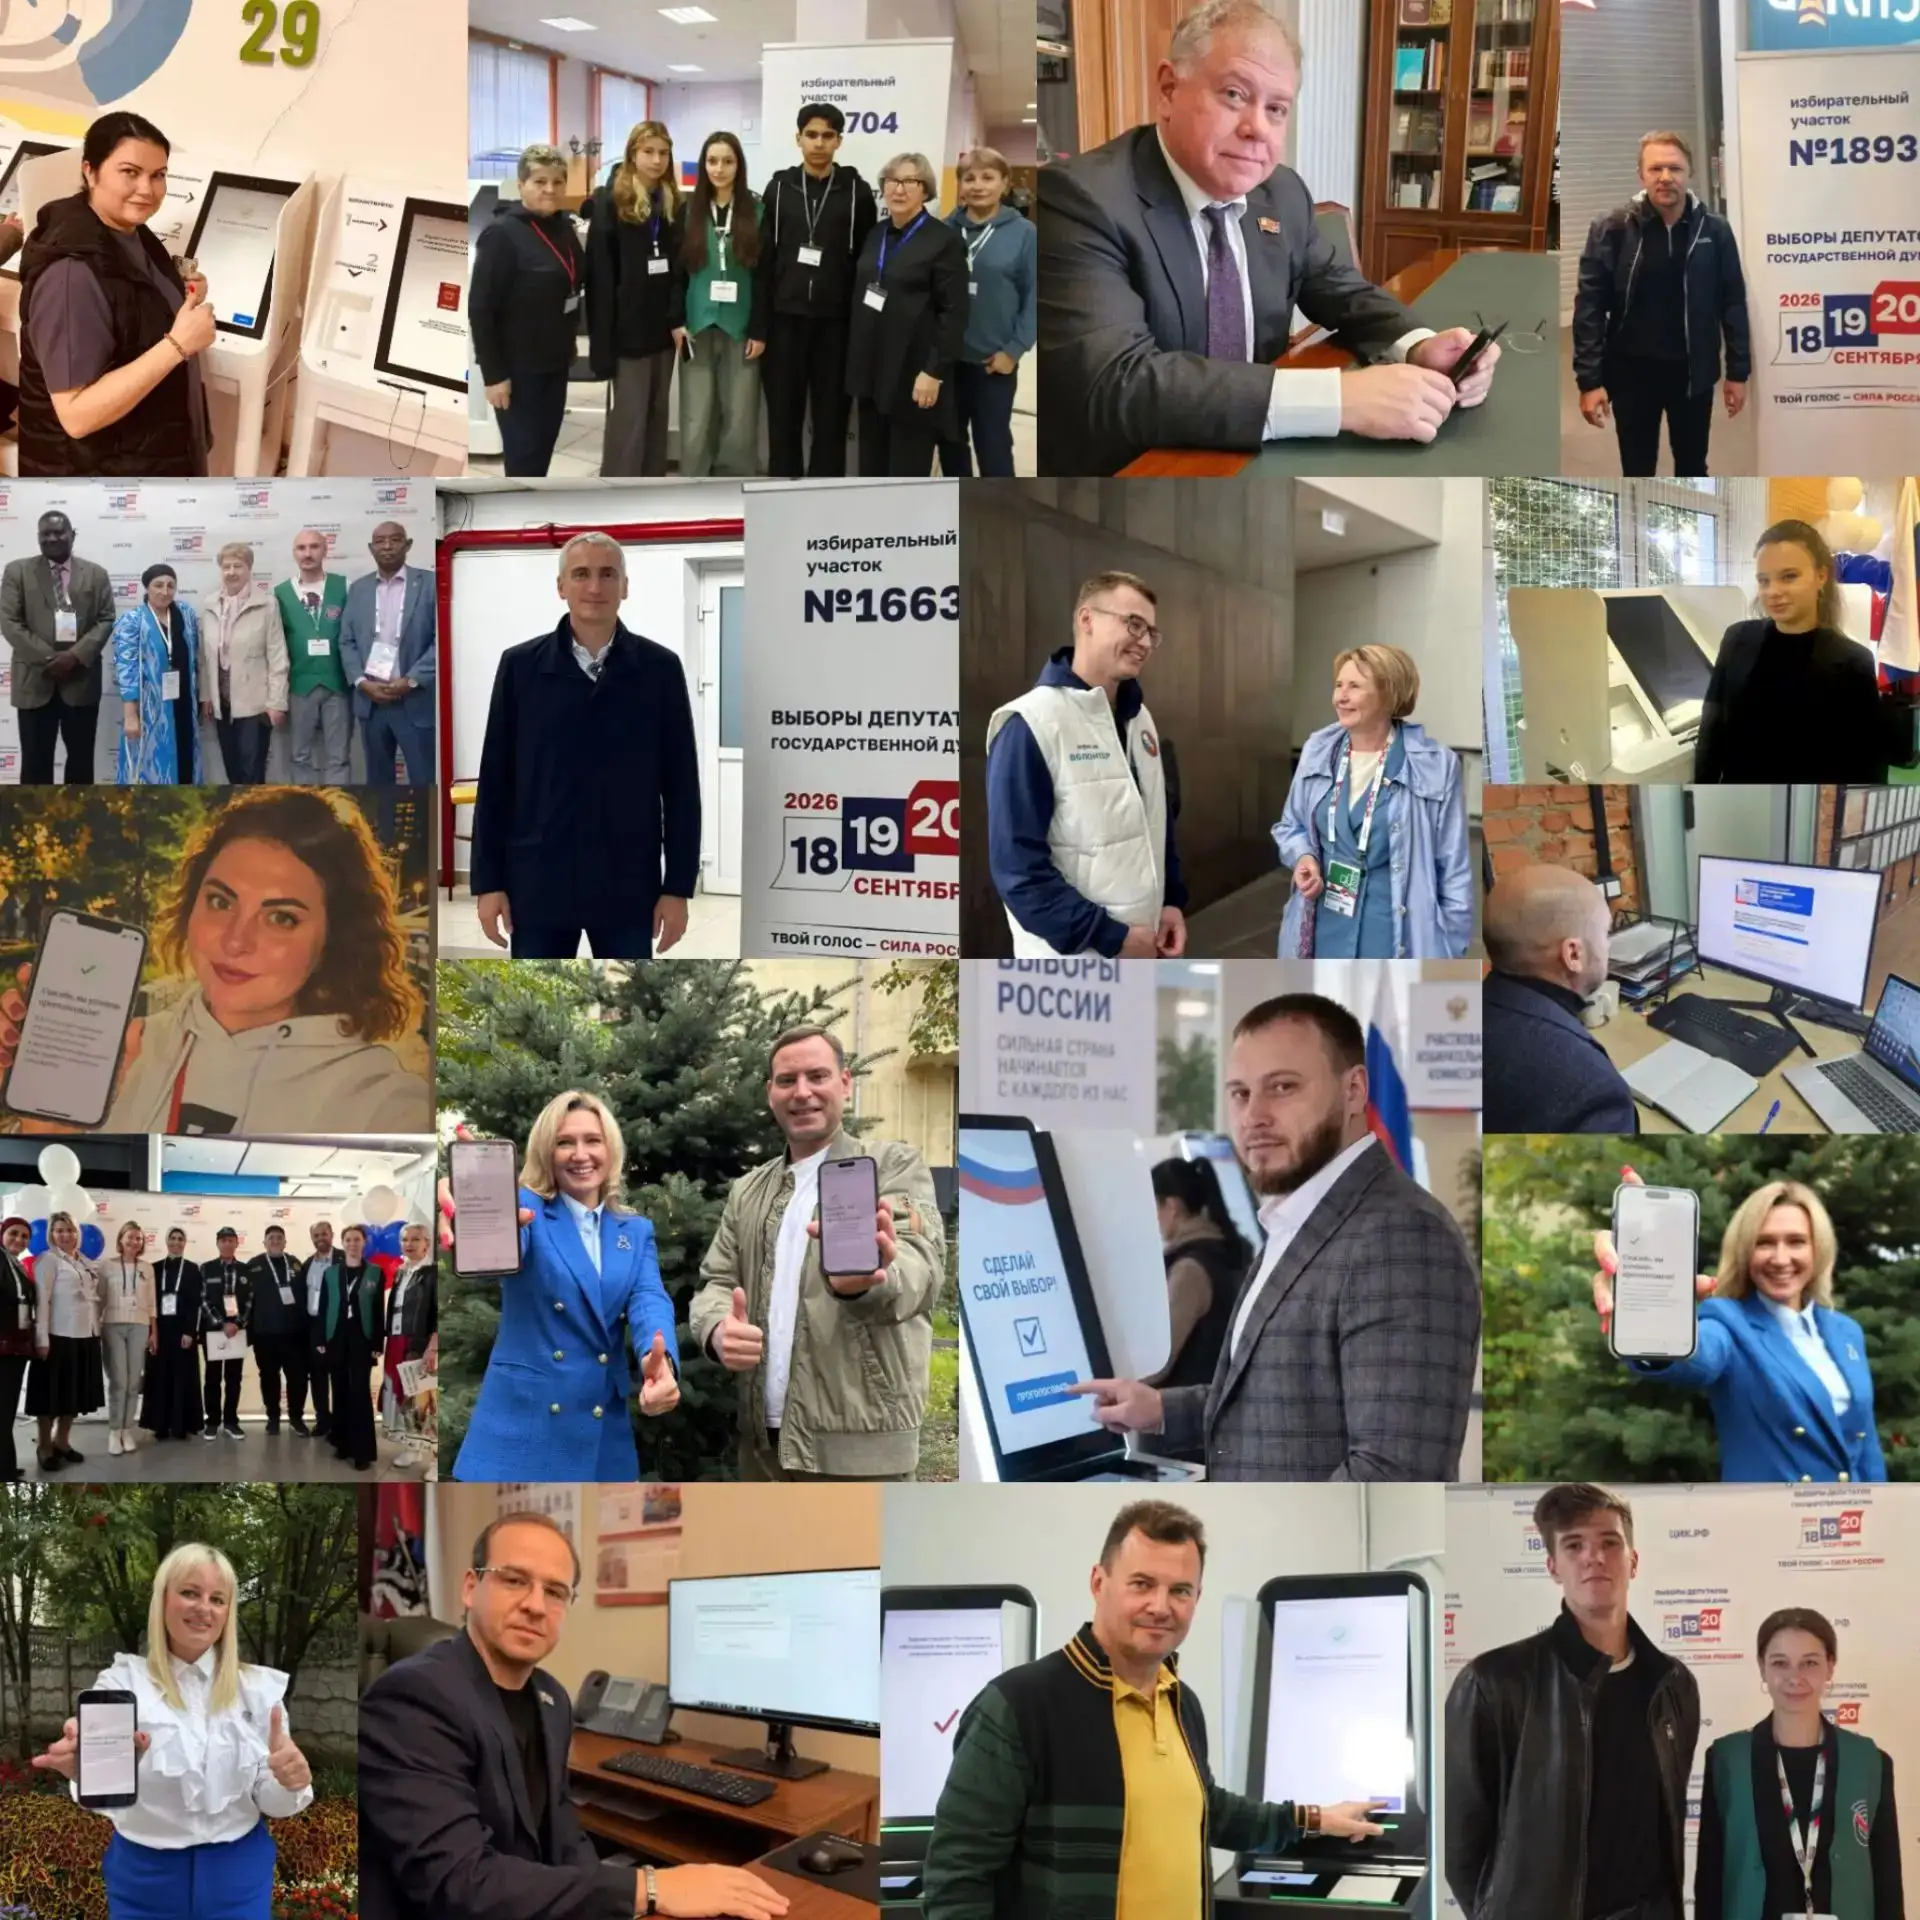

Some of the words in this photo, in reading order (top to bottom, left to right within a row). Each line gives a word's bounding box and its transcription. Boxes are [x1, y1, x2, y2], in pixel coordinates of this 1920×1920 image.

[240, 0, 320, 67] 29
[801, 76, 896, 89] избирательный
[801, 93, 848, 104] участок
[1790, 91, 1910, 110] избирательный
[843, 111, 899, 134] 704
[1791, 115, 1851, 129] участок
[1790, 134, 1918, 166] №1893
[1767, 232, 1837, 245] ВЫБОРЫ
[1767, 249, 1896, 264] ГОСУДАРСТВЕННОЙ
[1779, 293, 1821, 307] 2026
[1785, 325, 1822, 353] 18
[1829, 308, 1867, 336] 19
[1875, 294, 1920, 323] 20
[1773, 393, 1802, 404] ТВОЙ
[1805, 393, 1840, 403] ГОЛОС
[1853, 393, 1883, 402] СИЛА
[807, 530, 957, 553] избирательный
[806, 560, 883, 577] участок
[804, 585, 959, 624] №1663
[771, 710, 862, 727] ВЫБОРЫ
[771, 736, 939, 753] ГОСУДАРСТВЕННОЙ
[784, 792, 839, 811] 2026
[790, 836, 839, 875] 18
[850, 816, 900, 856] 19
[911, 798, 959, 839] 20
[854, 877, 959, 900] СЕНТЯБР
[771, 931, 810, 946] ТВОЙ
[813, 935, 863, 949] ГОЛОС
[880, 939, 921, 955] СИЛА
[926, 943, 959, 958] РОС
[998, 981, 1111, 1023] РОССИИ
[997, 1034, 1063, 1054] СИЛЬНАЯ
[998, 1057, 1087, 1078] НАЧИНАЕТСЯ
[1012, 1081, 1079, 1102] КАЖДОГО
[983, 1250, 1036, 1276] СДЕЛАЙ
[972, 1277, 1010, 1301] СВОЙ
[1012, 1276, 1058, 1296] ВЫБОР!
[1669, 1528, 1710, 1539] ЦИК.РФ
[1804, 1531, 1819, 1542] 18
[1822, 1523, 1837, 1535] 19
[1841, 1516, 1859, 1529] 20
[1527, 1538, 1541, 1551] 18
[1667, 1626, 1681, 1638] 18
[1683, 1620, 1698, 1632] 19
[1701, 1614, 1718, 1626] 20
[1839, 1707, 1857, 1720] 20
[1687, 1804, 1701, 1816] 19
